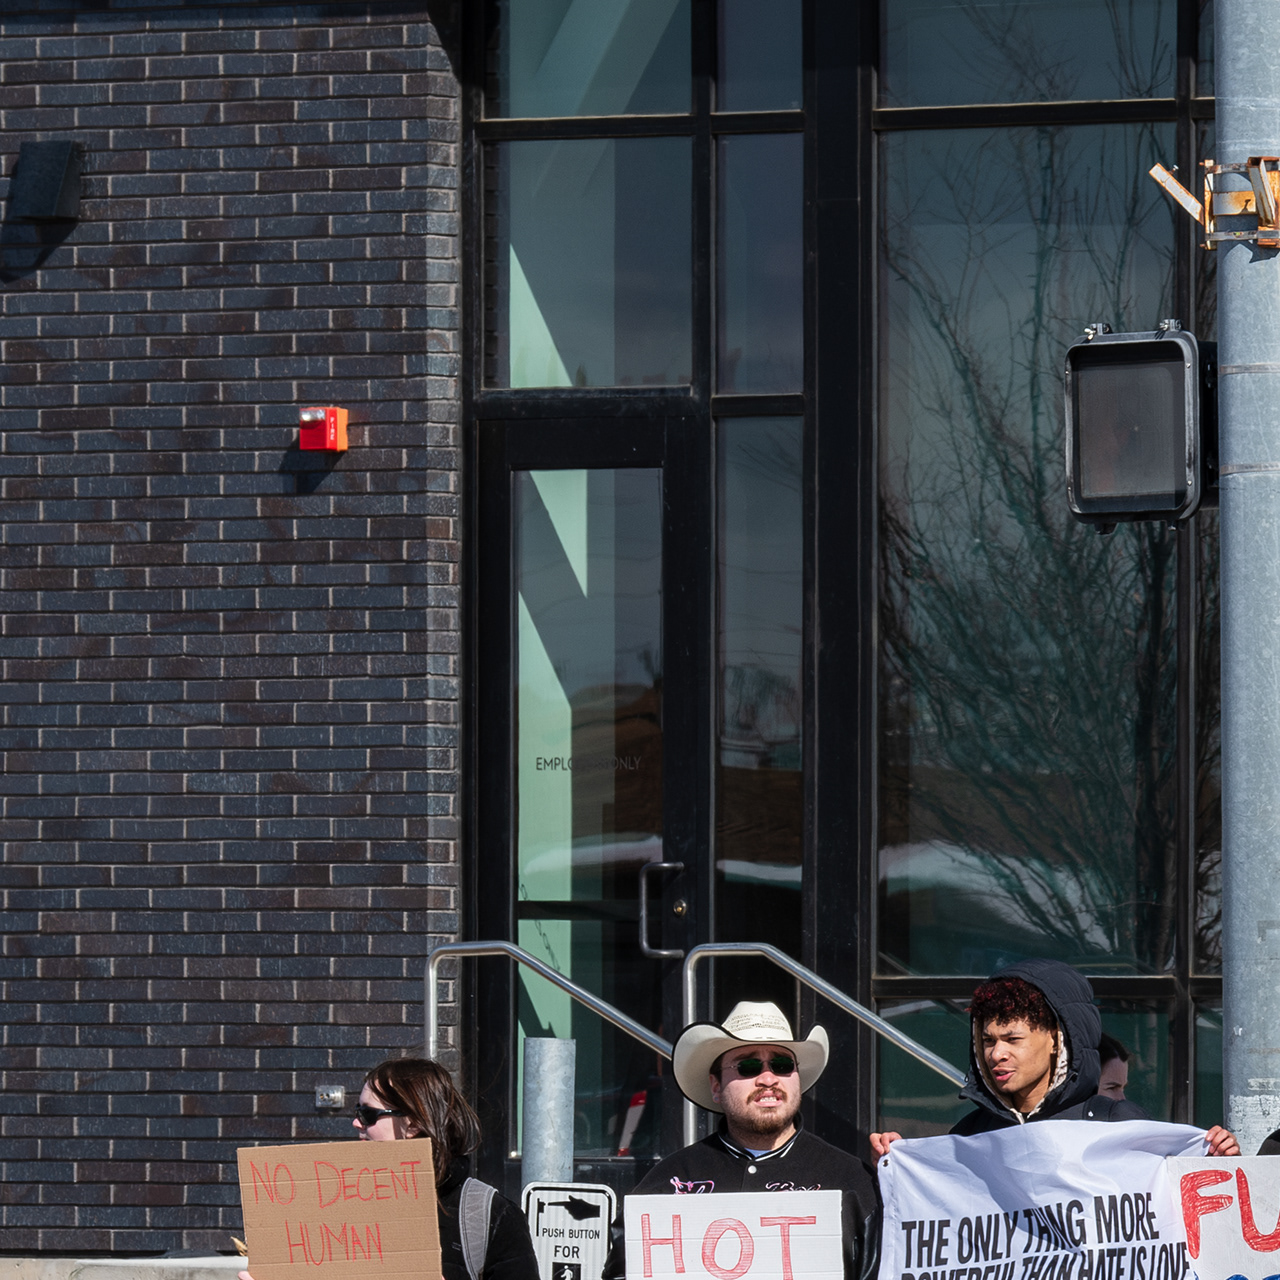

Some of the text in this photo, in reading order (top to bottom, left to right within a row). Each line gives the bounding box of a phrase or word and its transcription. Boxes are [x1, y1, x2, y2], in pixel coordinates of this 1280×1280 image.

[250, 1160, 421, 1209] NO DECENT
[285, 1219, 383, 1266] HUMAN
[542, 1227, 600, 1240] PUSH BUTTON
[554, 1245, 580, 1258] FOR
[641, 1213, 817, 1280] HOT
[901, 1219, 950, 1268] THE
[957, 1210, 1018, 1264] ONLY
[1094, 1192, 1160, 1244] MORE
